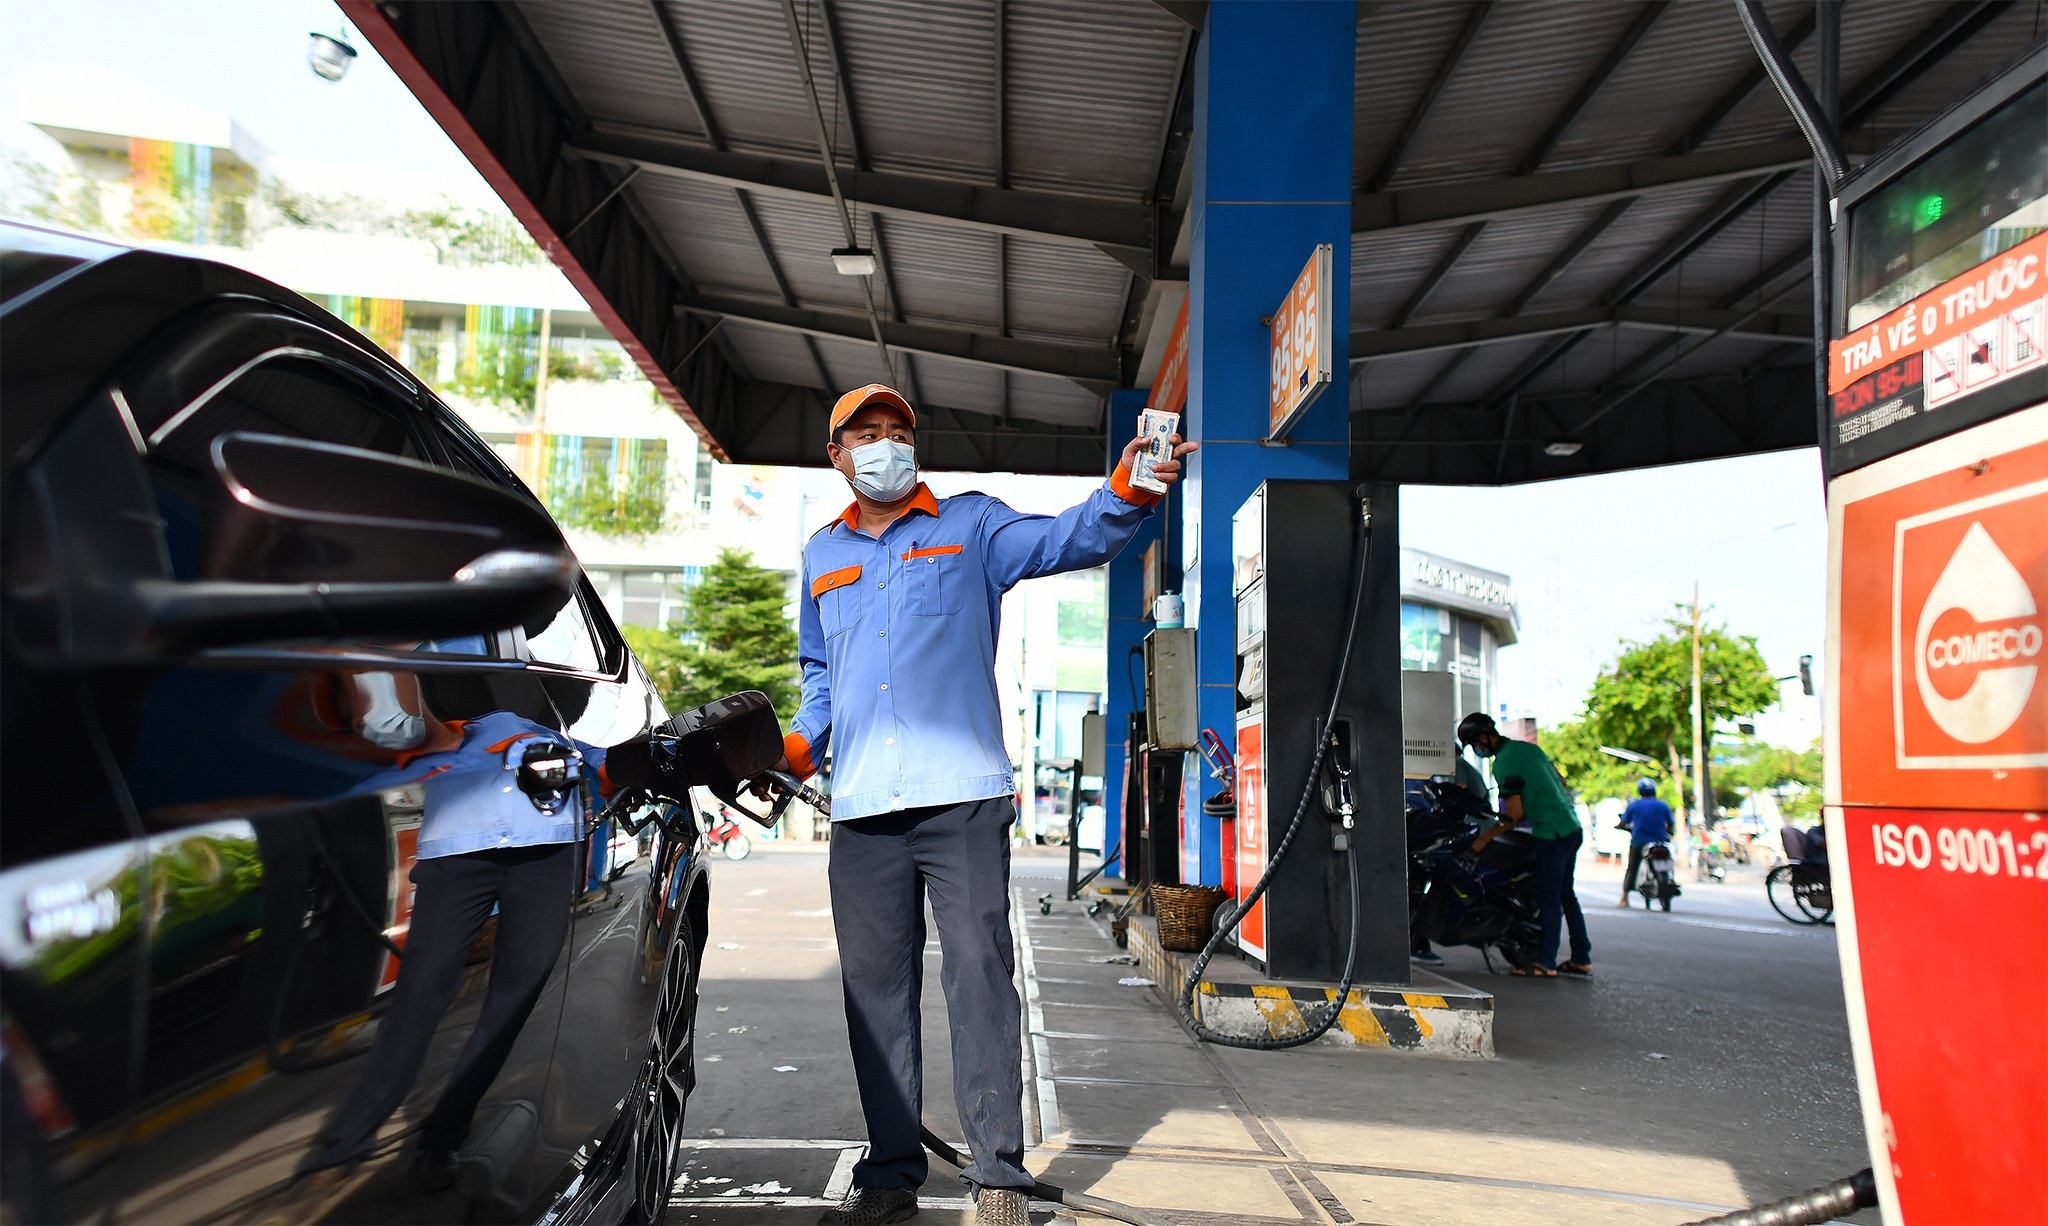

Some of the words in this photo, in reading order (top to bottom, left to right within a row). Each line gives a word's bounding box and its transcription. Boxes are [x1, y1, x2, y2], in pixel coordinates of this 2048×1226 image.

[1299, 268, 1312, 304] RON
[1294, 291, 1316, 372] 95
[1841, 324, 1882, 375] TRẢ
[1886, 303, 1917, 352] VỀ
[1272, 330, 1291, 403] 95
[1926, 624, 2044, 669] COMECO
[1871, 823, 1932, 870] ISO
